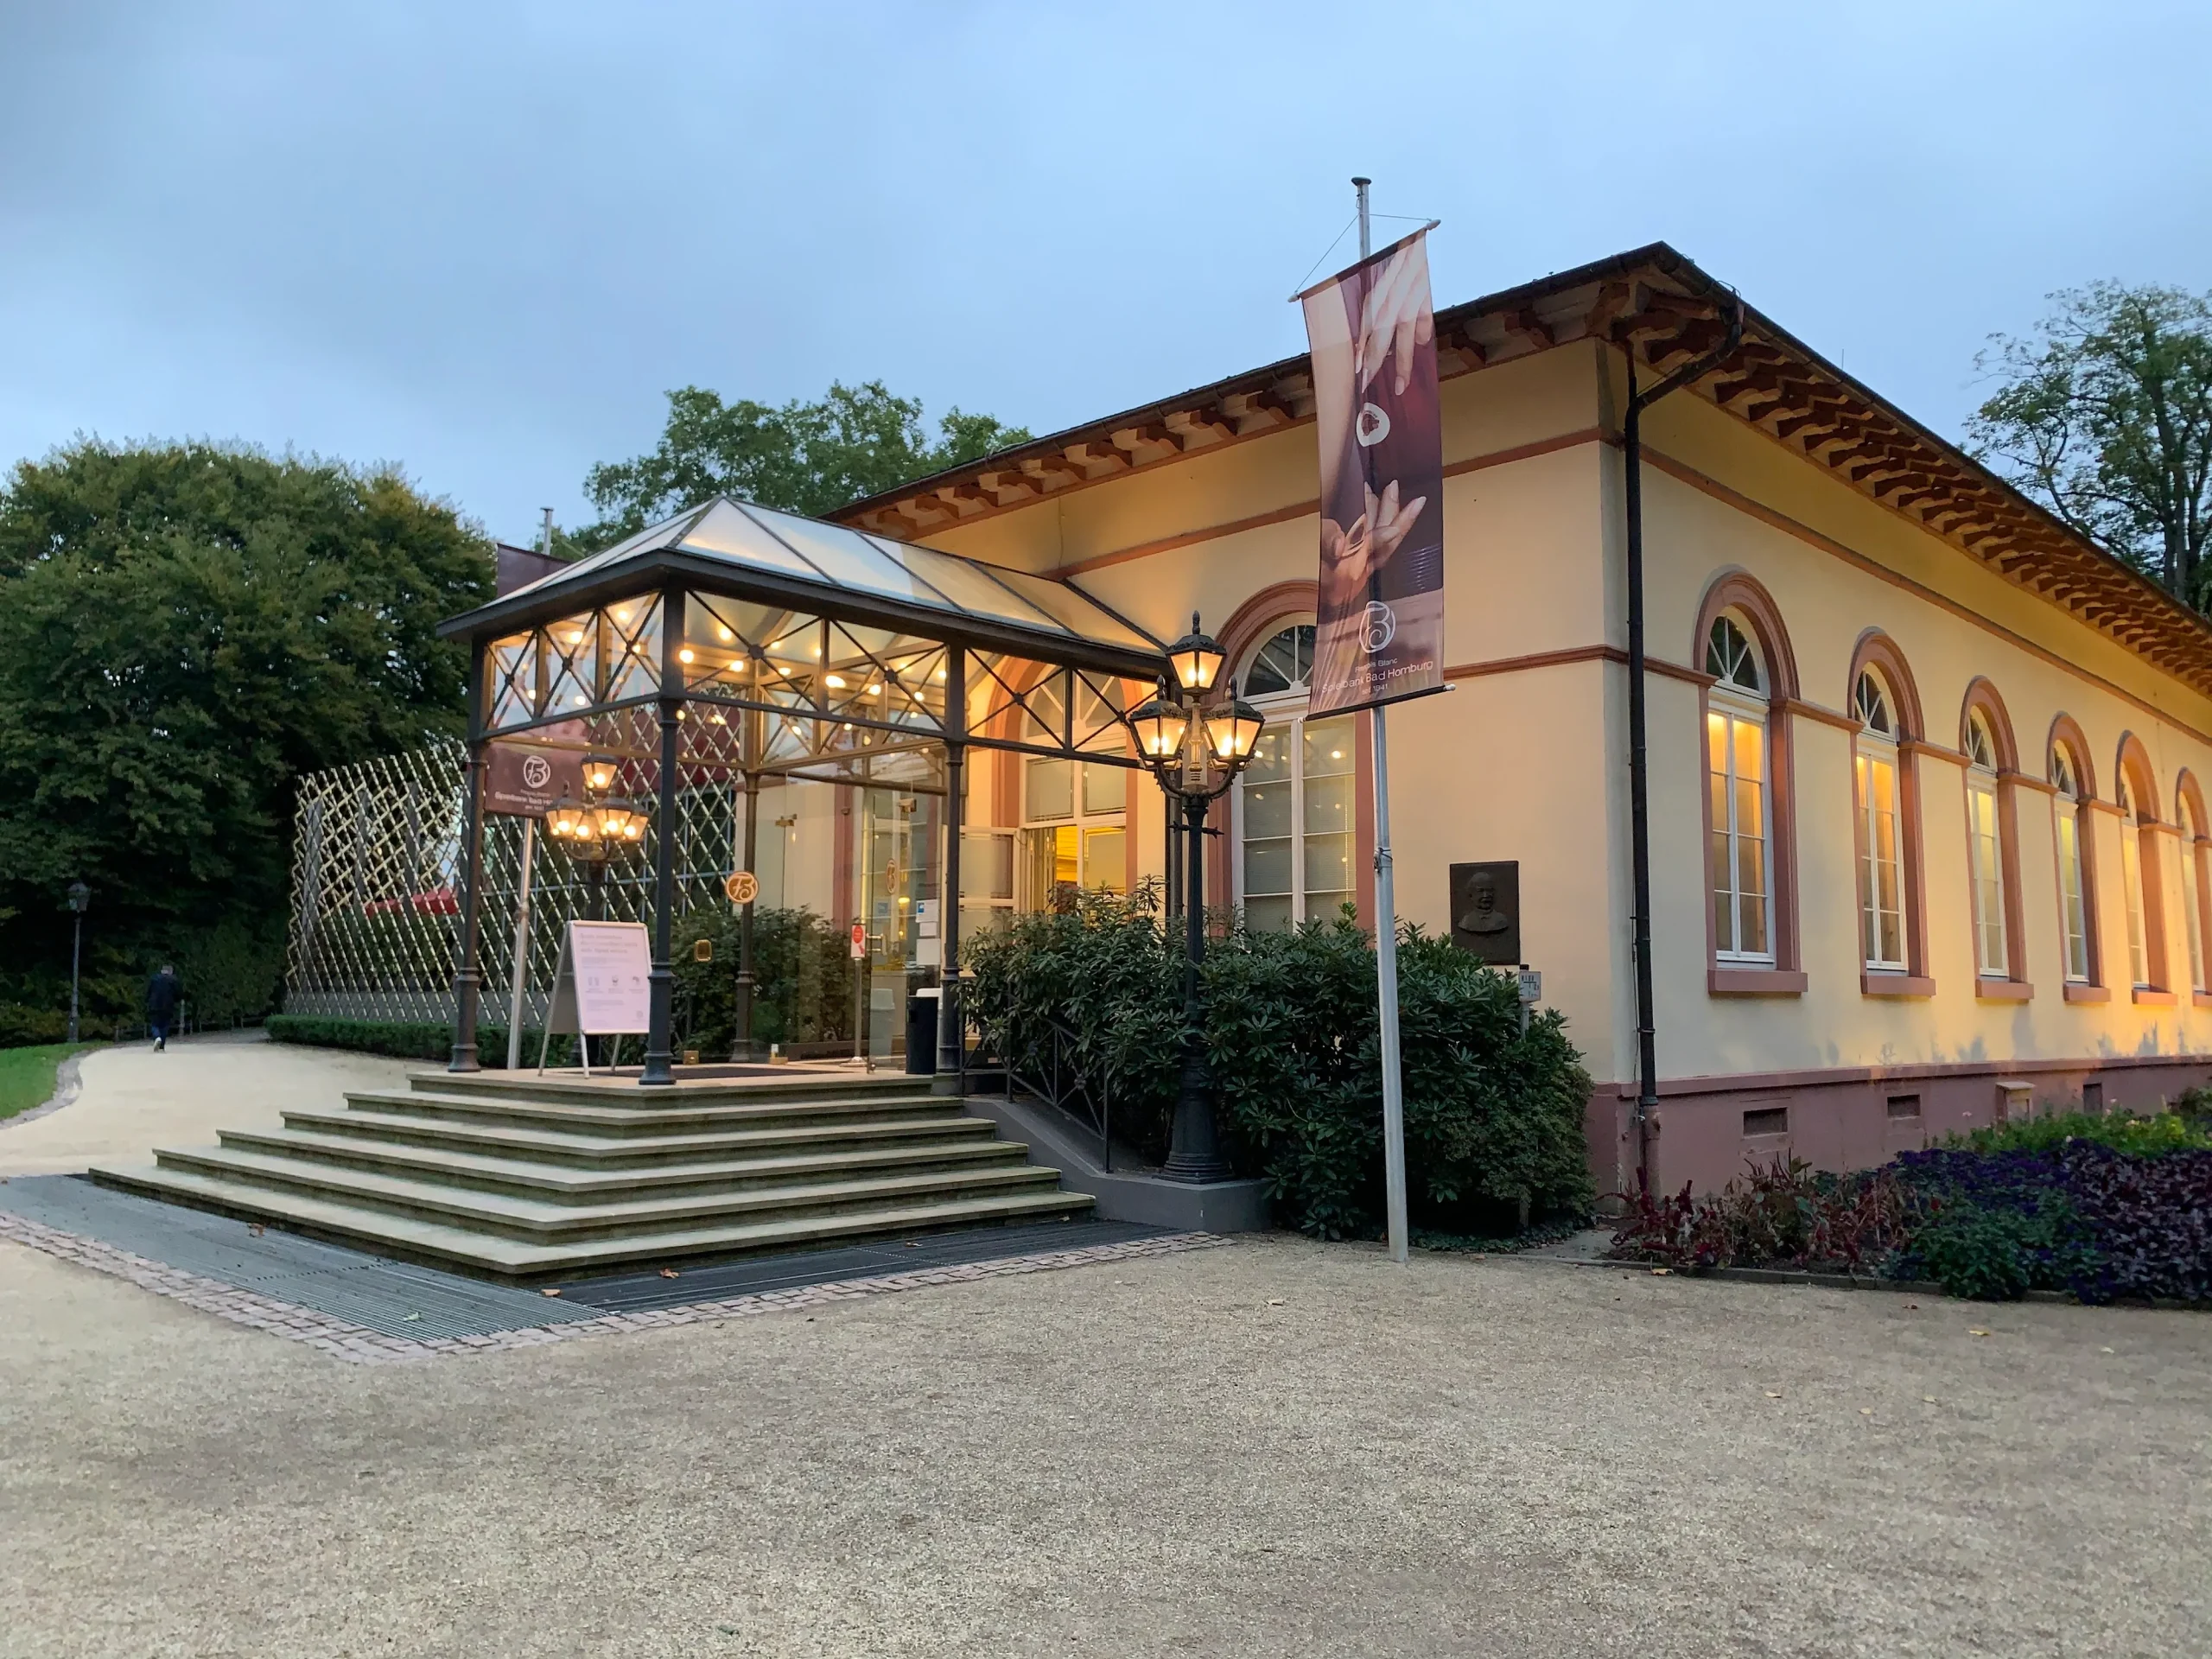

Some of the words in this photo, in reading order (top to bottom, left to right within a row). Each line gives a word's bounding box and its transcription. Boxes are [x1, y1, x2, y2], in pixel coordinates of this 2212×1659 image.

[1378, 658, 1398, 667] Blanc
[1365, 671, 1386, 683] Bad
[1388, 660, 1433, 679] Homburg
